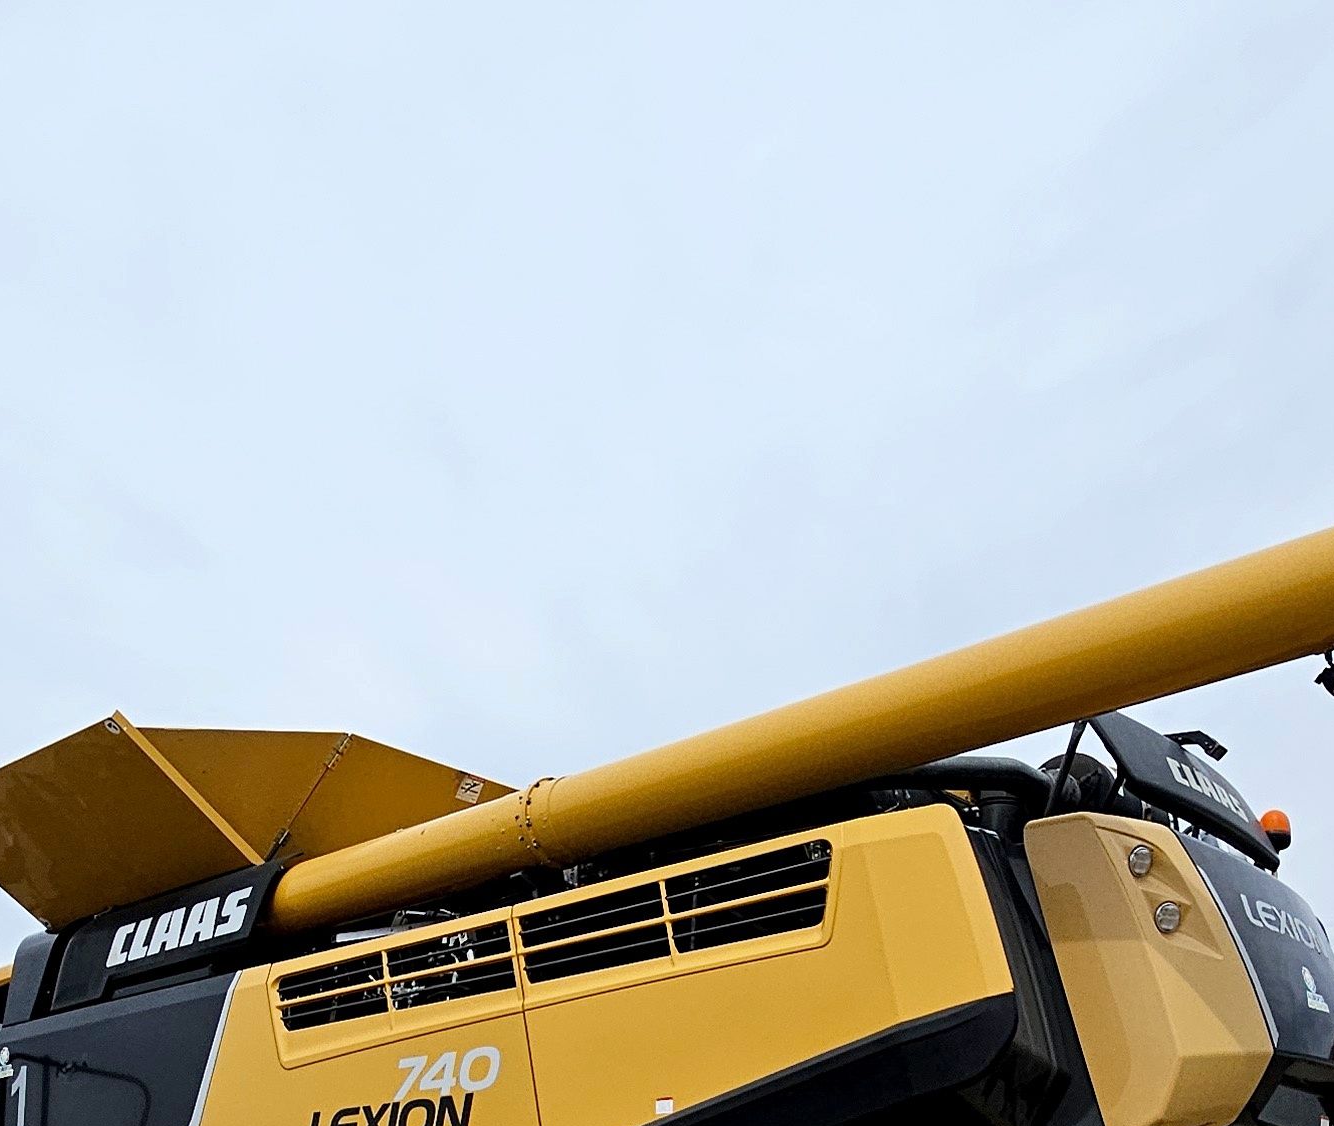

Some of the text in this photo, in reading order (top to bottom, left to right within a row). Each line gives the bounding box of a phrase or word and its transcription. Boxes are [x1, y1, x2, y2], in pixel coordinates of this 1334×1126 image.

[1166, 757, 1249, 823] CLAAS
[106, 886, 253, 968] CLAAS
[394, 1045, 501, 1102] 740
